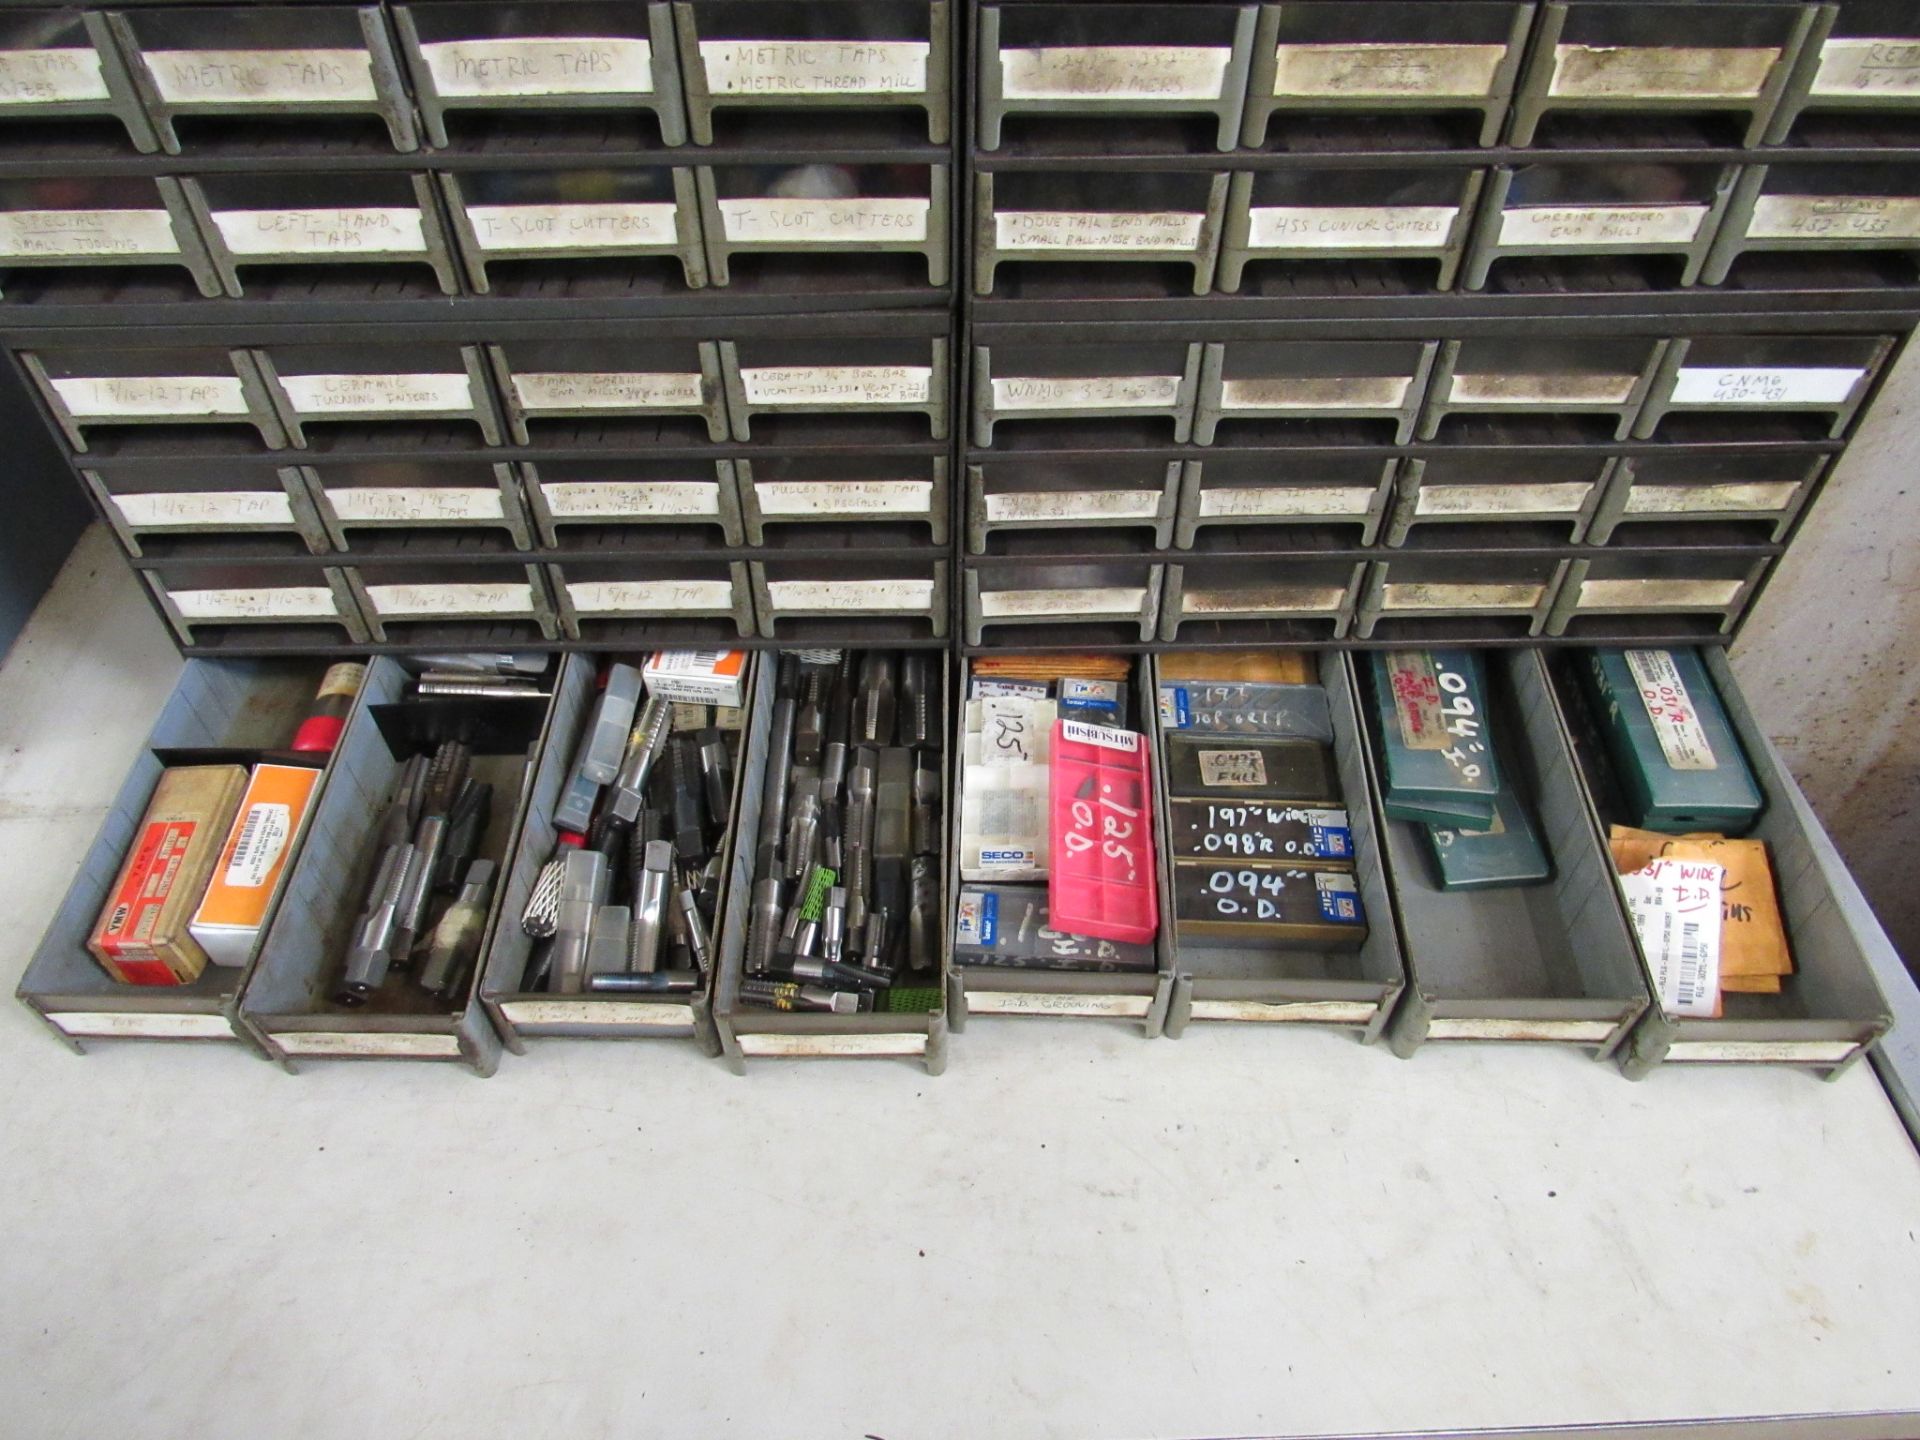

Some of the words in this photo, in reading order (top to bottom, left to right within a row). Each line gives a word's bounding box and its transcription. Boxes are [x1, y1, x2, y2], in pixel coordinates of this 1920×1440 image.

[28, 55, 79, 73] TAPS
[737, 47, 817, 66] METRIC
[837, 46, 888, 64] TAPS
[454, 53, 540, 79] METRIC
[554, 51, 612, 75] TAPS
[173, 64, 268, 88] METRIC
[282, 63, 345, 86] TAPS
[739, 74, 806, 89] METRIC
[812, 74, 867, 89] THREAD
[338, 212, 389, 228] HAND
[510, 216, 556, 234] SLOT
[569, 216, 651, 231] CUTTERS
[769, 210, 815, 227] SLOT
[829, 211, 914, 228] CUTTERS
[1111, 216, 1142, 228] END
[1148, 216, 1188, 227] MILLS
[306, 231, 361, 247] TAPS
[1018, 233, 1062, 245] SMALL
[1135, 235, 1160, 245] END
[1550, 227, 1582, 238] END
[1599, 226, 1642, 237] MILLS
[13, 238, 65, 253] SMALL
[72, 236, 138, 250] TOOLING
[324, 376, 406, 392] CERAMIC
[175, 386, 220, 401] TAPS
[311, 393, 376, 406] TURNING
[825, 484, 853, 492] TAPS
[892, 484, 921, 492] TAPS
[473, 591, 509, 604] TAP
[672, 586, 704, 601] TAP
[981, 850, 1024, 860] SECO
[1680, 864, 1716, 881] WIDE
[110, 906, 128, 932] YMW
